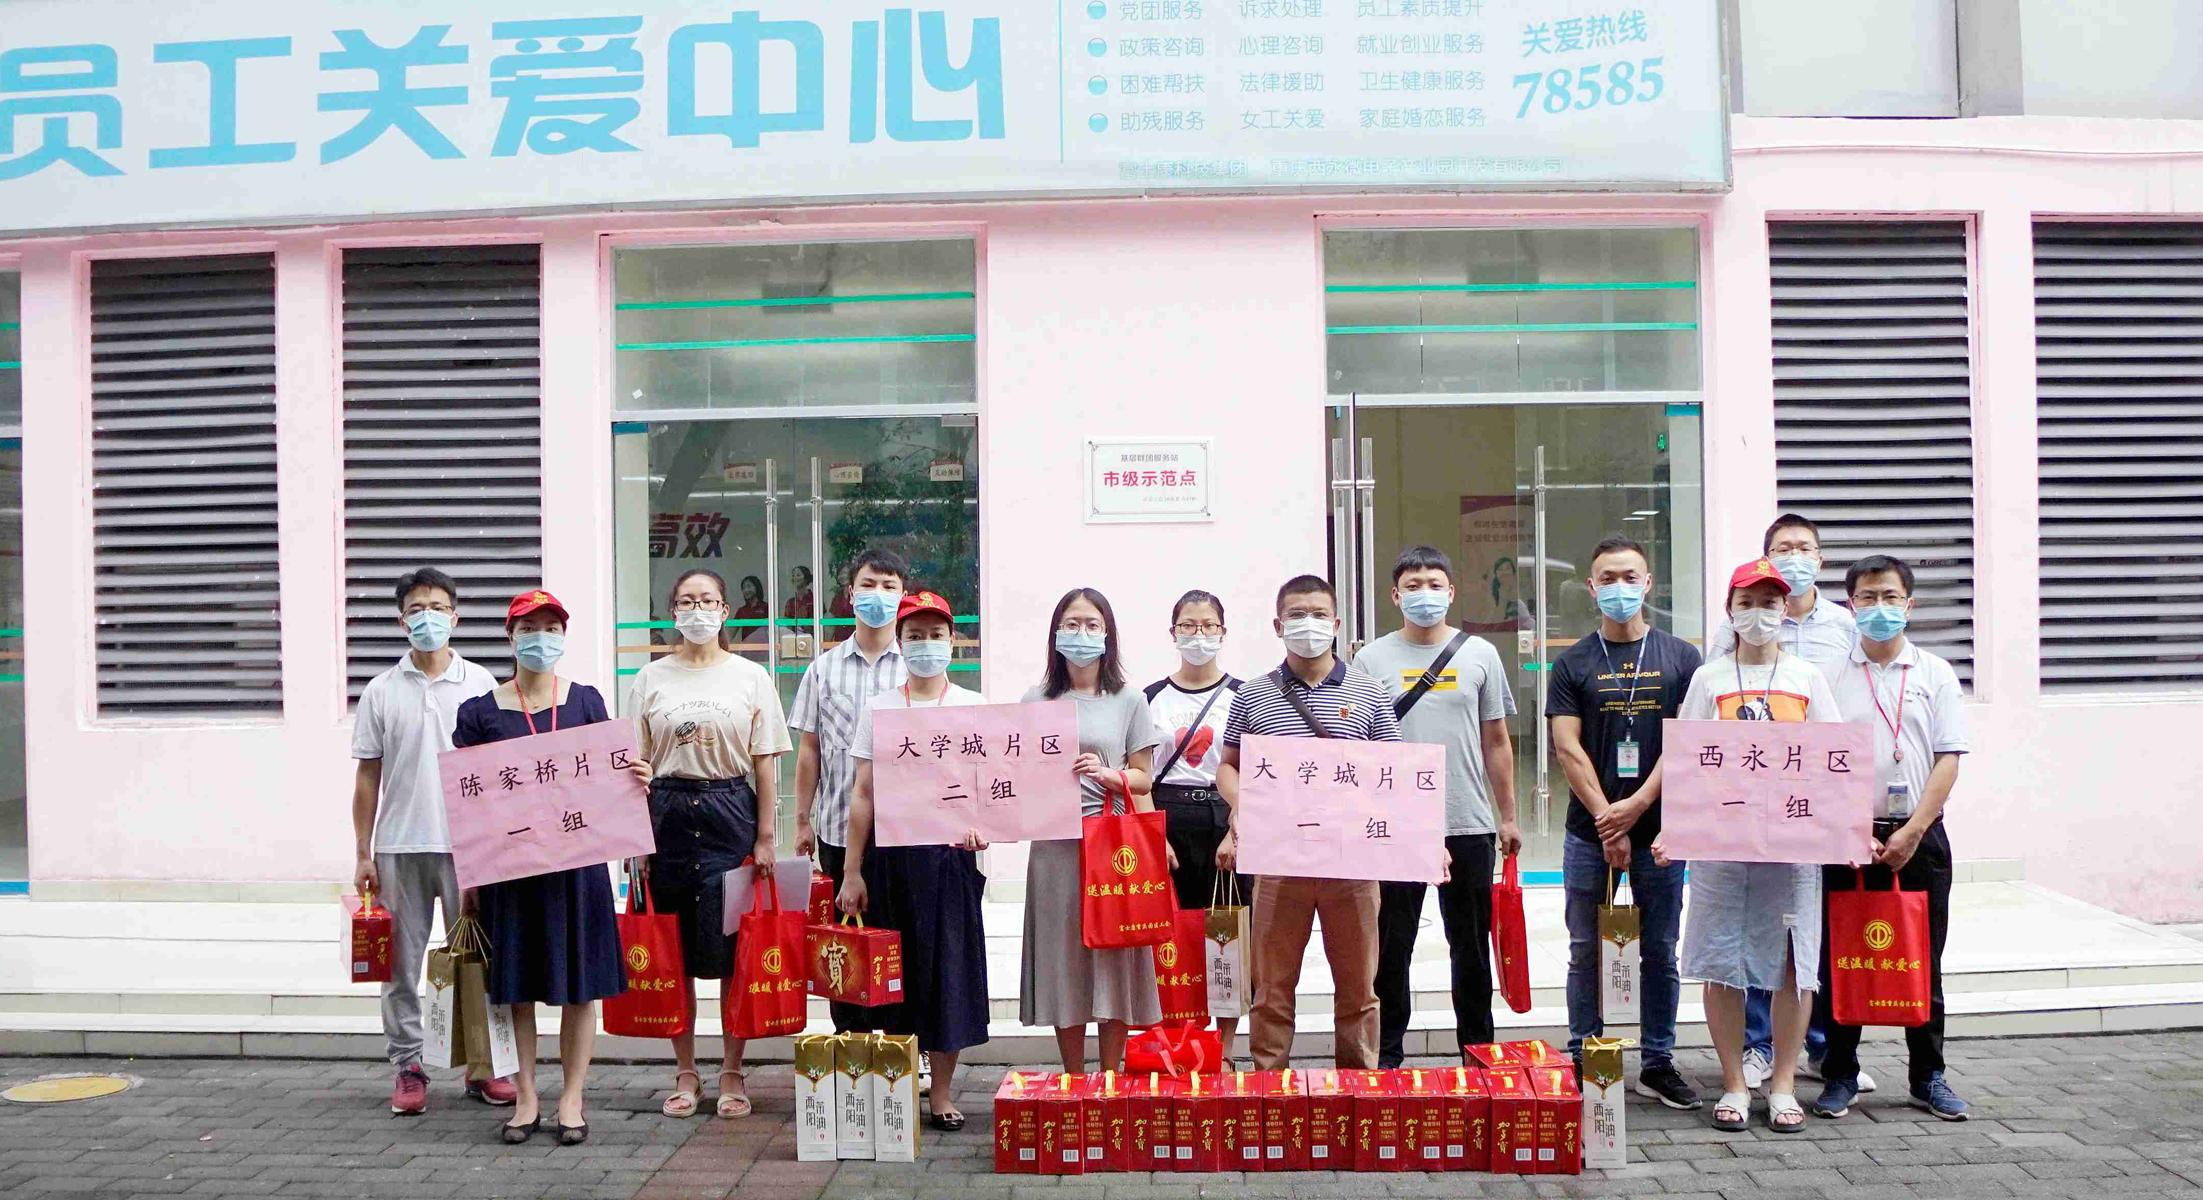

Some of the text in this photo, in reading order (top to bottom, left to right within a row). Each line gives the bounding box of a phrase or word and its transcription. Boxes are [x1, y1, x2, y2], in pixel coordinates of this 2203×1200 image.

[1119, 0, 1202, 21] 党团服务
[1239, 0, 1322, 19] 诉求处理
[1357, 33, 1485, 55] 就业创业服务
[1521, 9, 1648, 58] 关爱热线
[1119, 38, 1204, 58] 政策咨询
[1239, 35, 1323, 56] 心理咨询
[1120, 74, 1206, 95] 困难帮扶
[1239, 71, 1324, 93] 法律援助
[1359, 70, 1486, 93] 卫生健康服务
[1511, 56, 1664, 120] 78585
[0, 8, 1006, 181] 员工关爱中心
[1120, 110, 1206, 132] 助残服务
[1240, 108, 1325, 130] 女工关爱
[1359, 107, 1487, 129] 家庭婚恋服务
[1104, 470, 1196, 487] 市级示范点
[896, 733, 1062, 759] 大学城片区
[1699, 744, 1850, 773] 西永片区
[459, 748, 632, 798] 陈家桥片区
[1252, 757, 1437, 791] 大学城片区
[941, 778, 1016, 801] 二组
[1722, 795, 1813, 819] 一组
[507, 810, 588, 835] 一组
[1297, 817, 1391, 839] 一组
